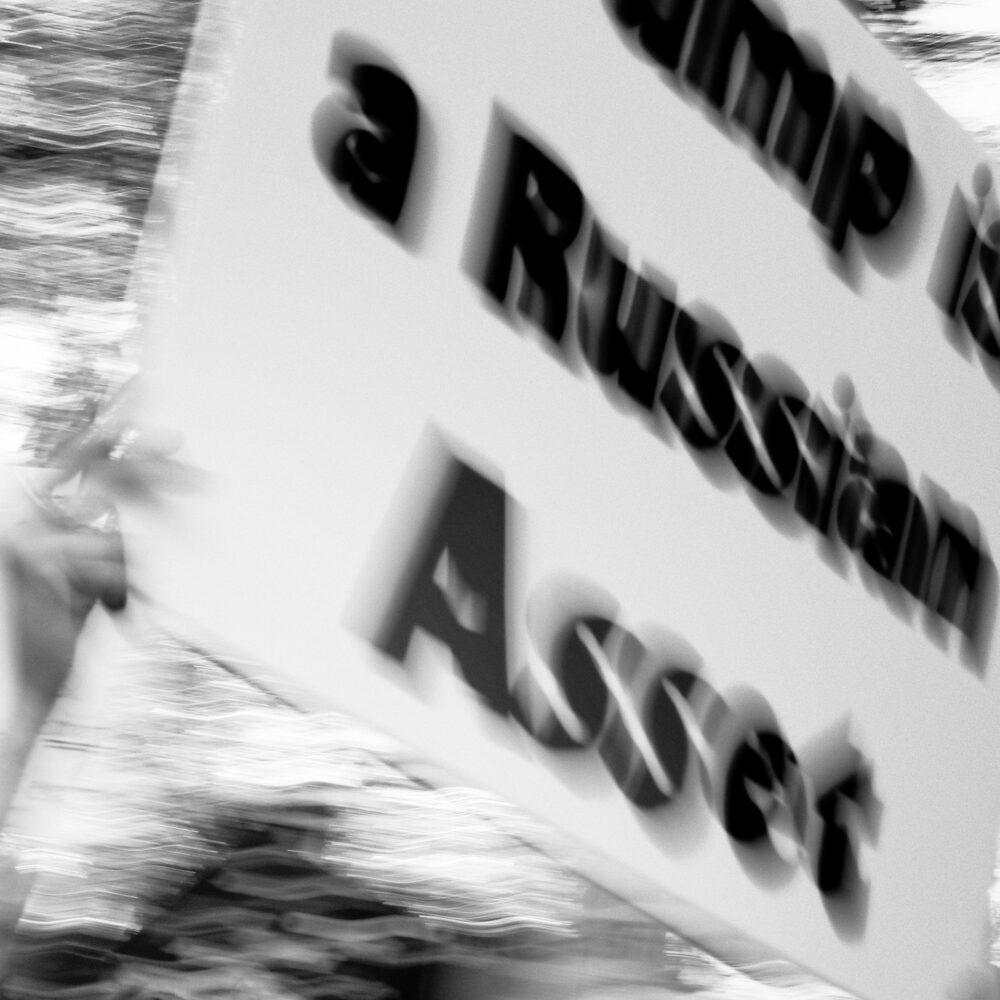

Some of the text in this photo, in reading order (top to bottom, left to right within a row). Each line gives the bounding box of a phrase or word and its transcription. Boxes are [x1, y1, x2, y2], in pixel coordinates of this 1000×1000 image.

[313, 30, 999, 682] a Russian
[342, 416, 884, 944] Asset
